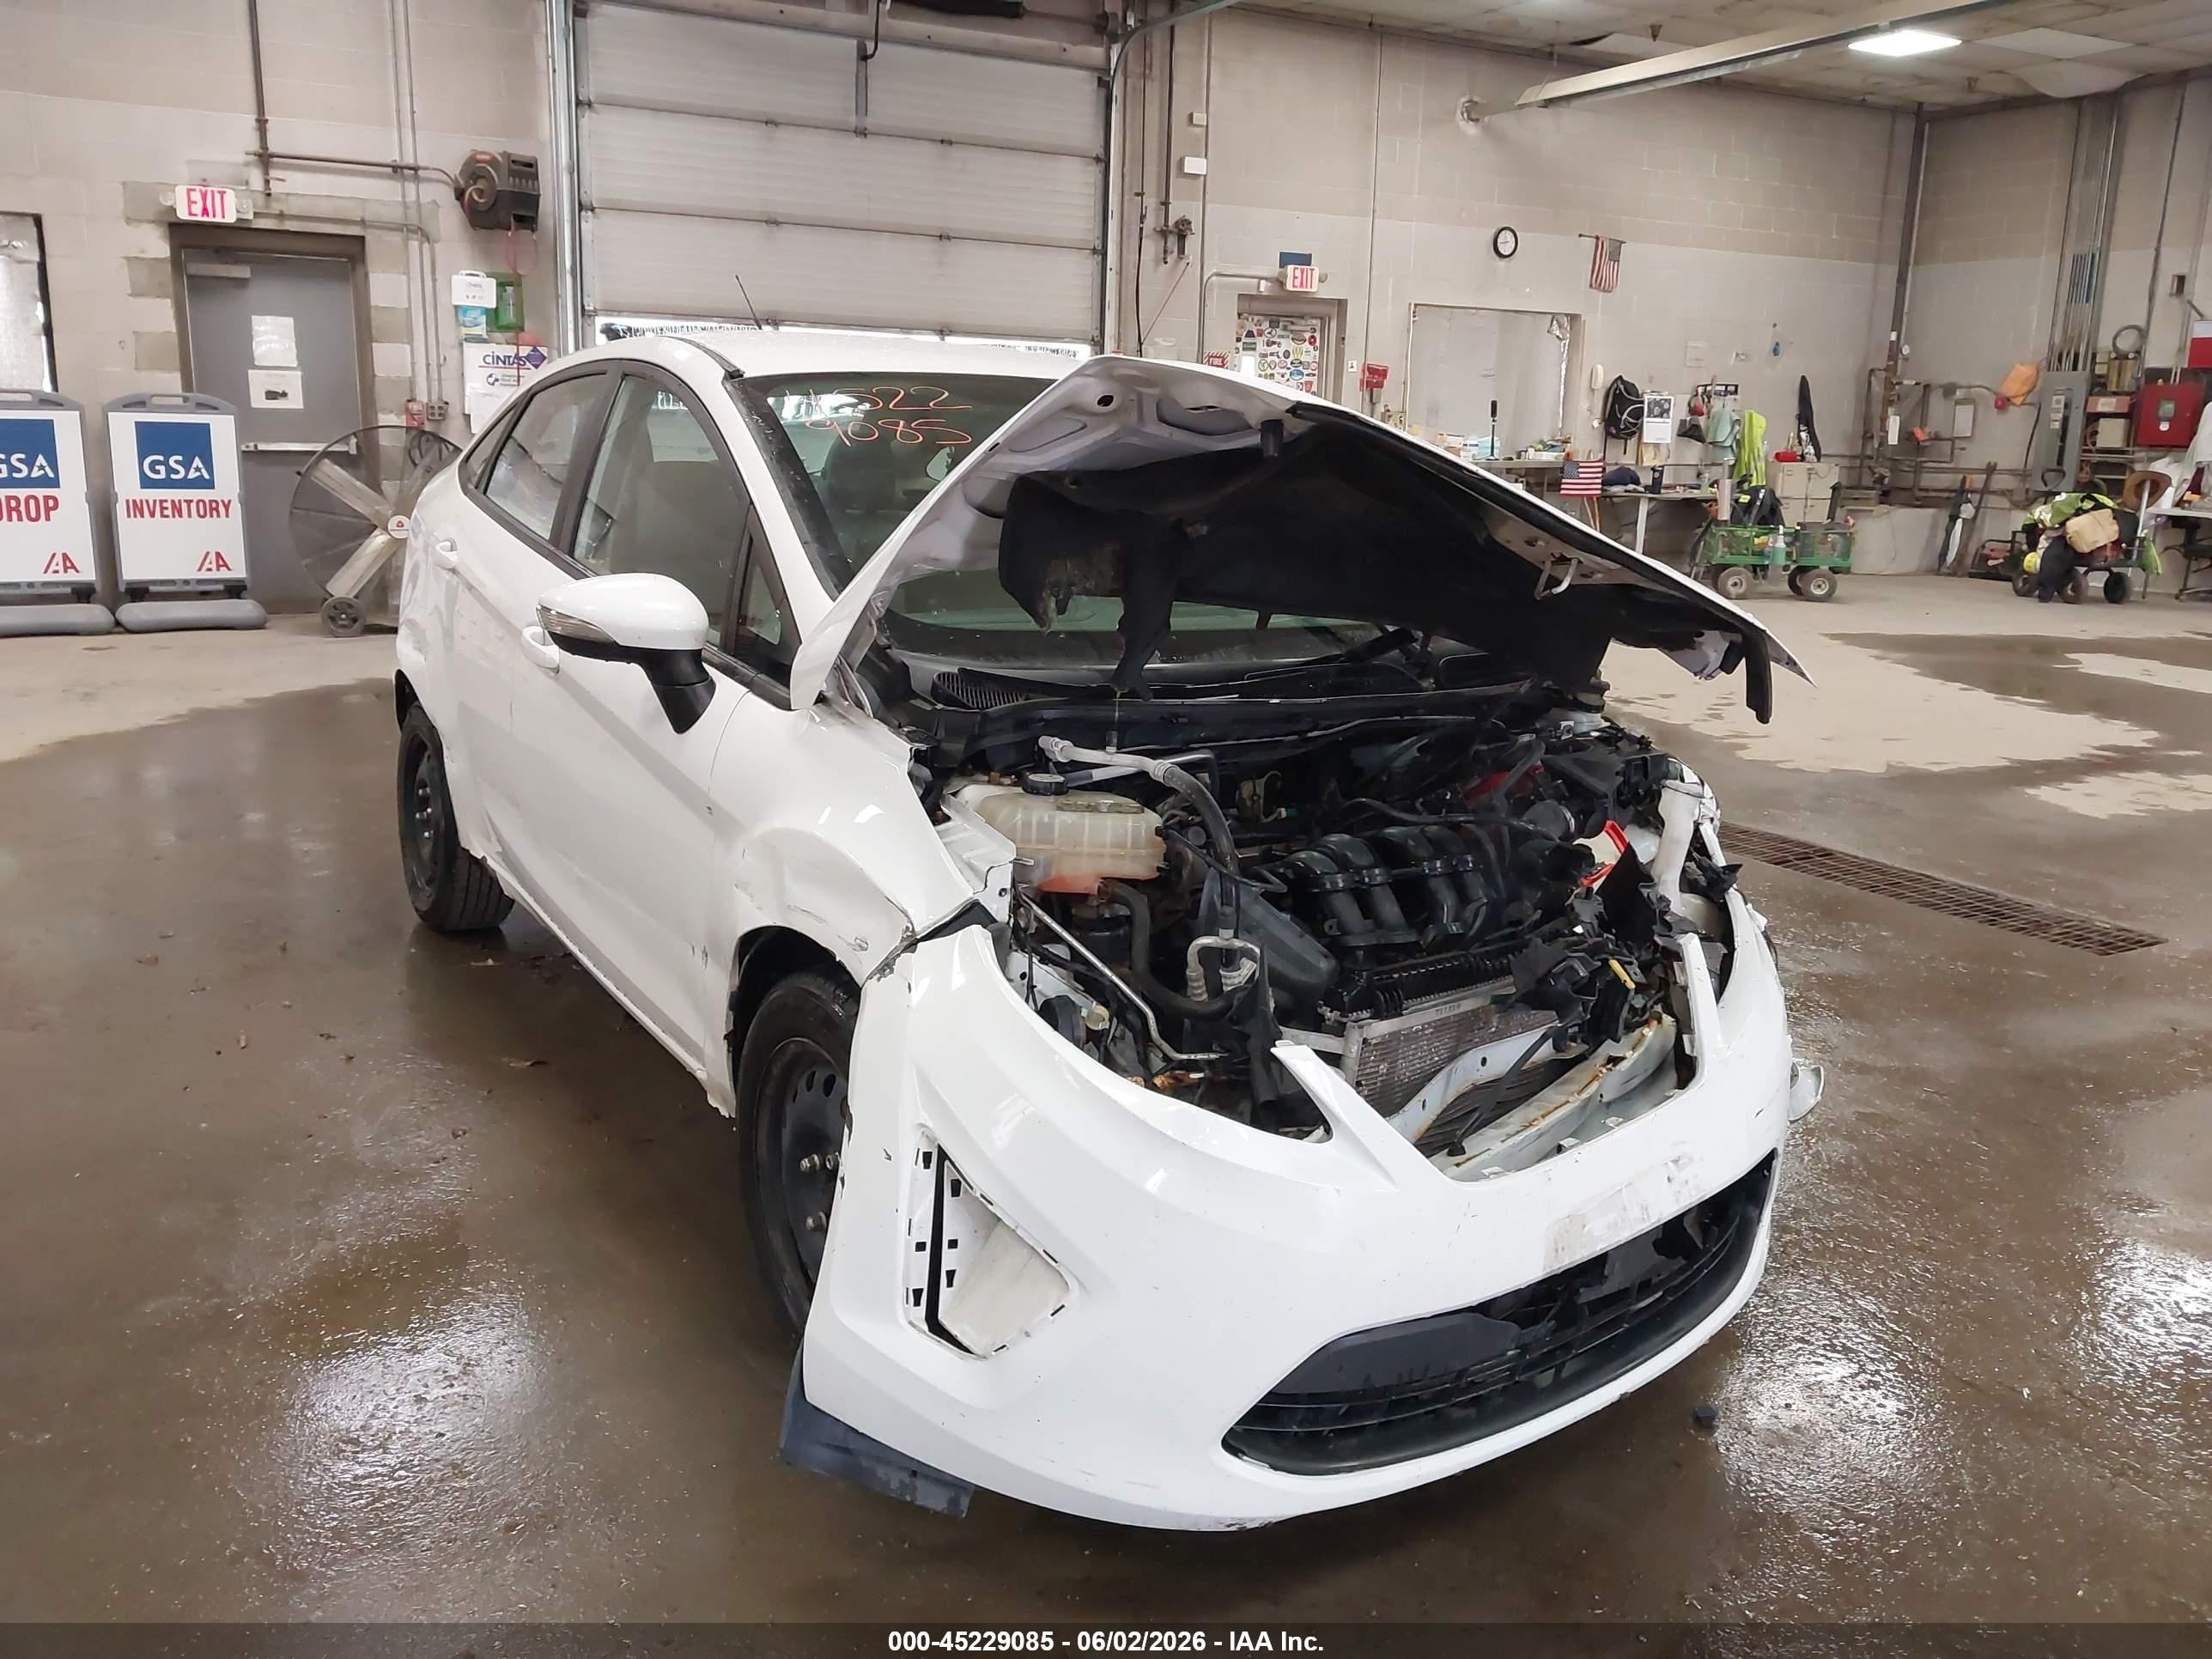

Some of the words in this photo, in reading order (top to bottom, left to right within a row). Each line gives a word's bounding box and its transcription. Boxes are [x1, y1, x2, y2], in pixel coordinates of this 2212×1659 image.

[186, 188, 227, 219] EXIT
[1292, 267, 1316, 289] EXIT
[805, 419, 972, 447] 9085
[143, 454, 210, 480] GSA
[0, 494, 60, 523] ROP
[125, 499, 232, 520] INVENTORY
